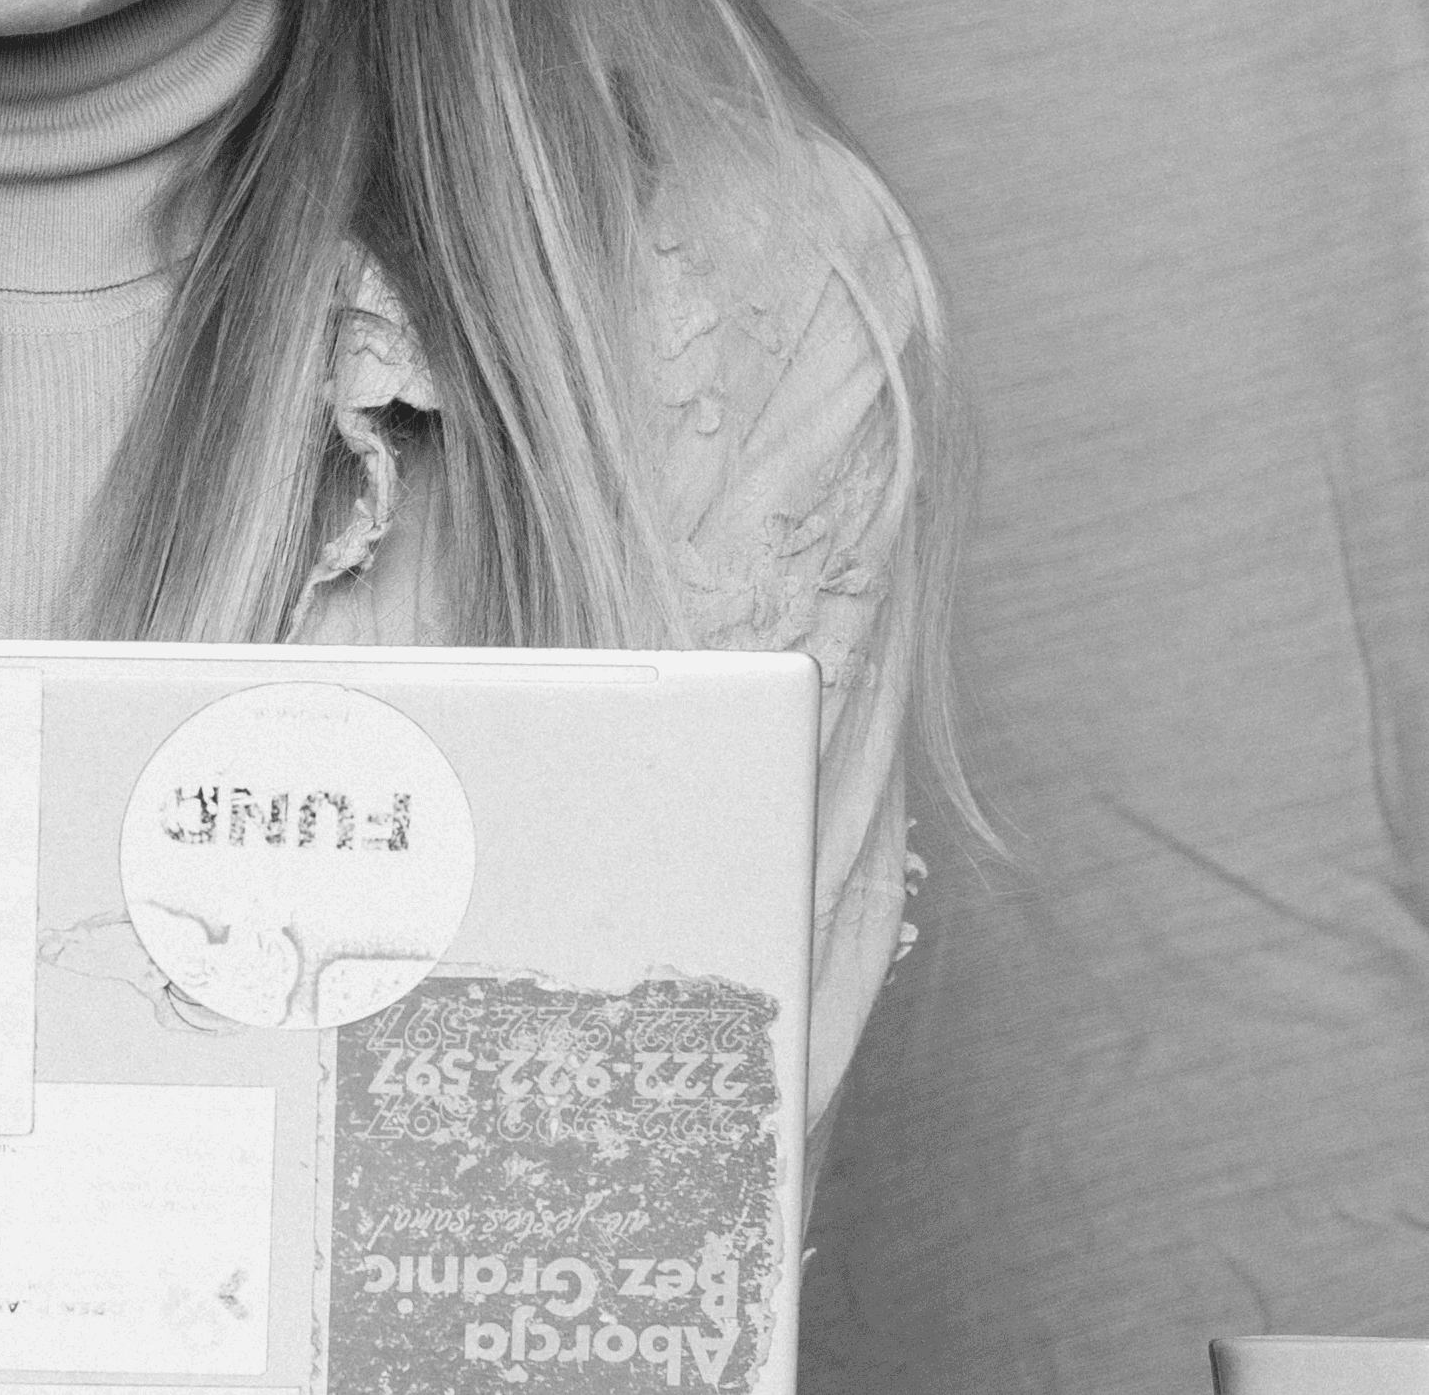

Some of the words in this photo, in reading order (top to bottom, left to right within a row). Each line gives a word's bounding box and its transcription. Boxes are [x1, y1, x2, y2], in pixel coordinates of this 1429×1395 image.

[366, 1047, 746, 1095] 222-922-597
[362, 1253, 596, 1316] Granic
[616, 1256, 738, 1319] Bez
[463, 1304, 740, 1385] Aborcja
